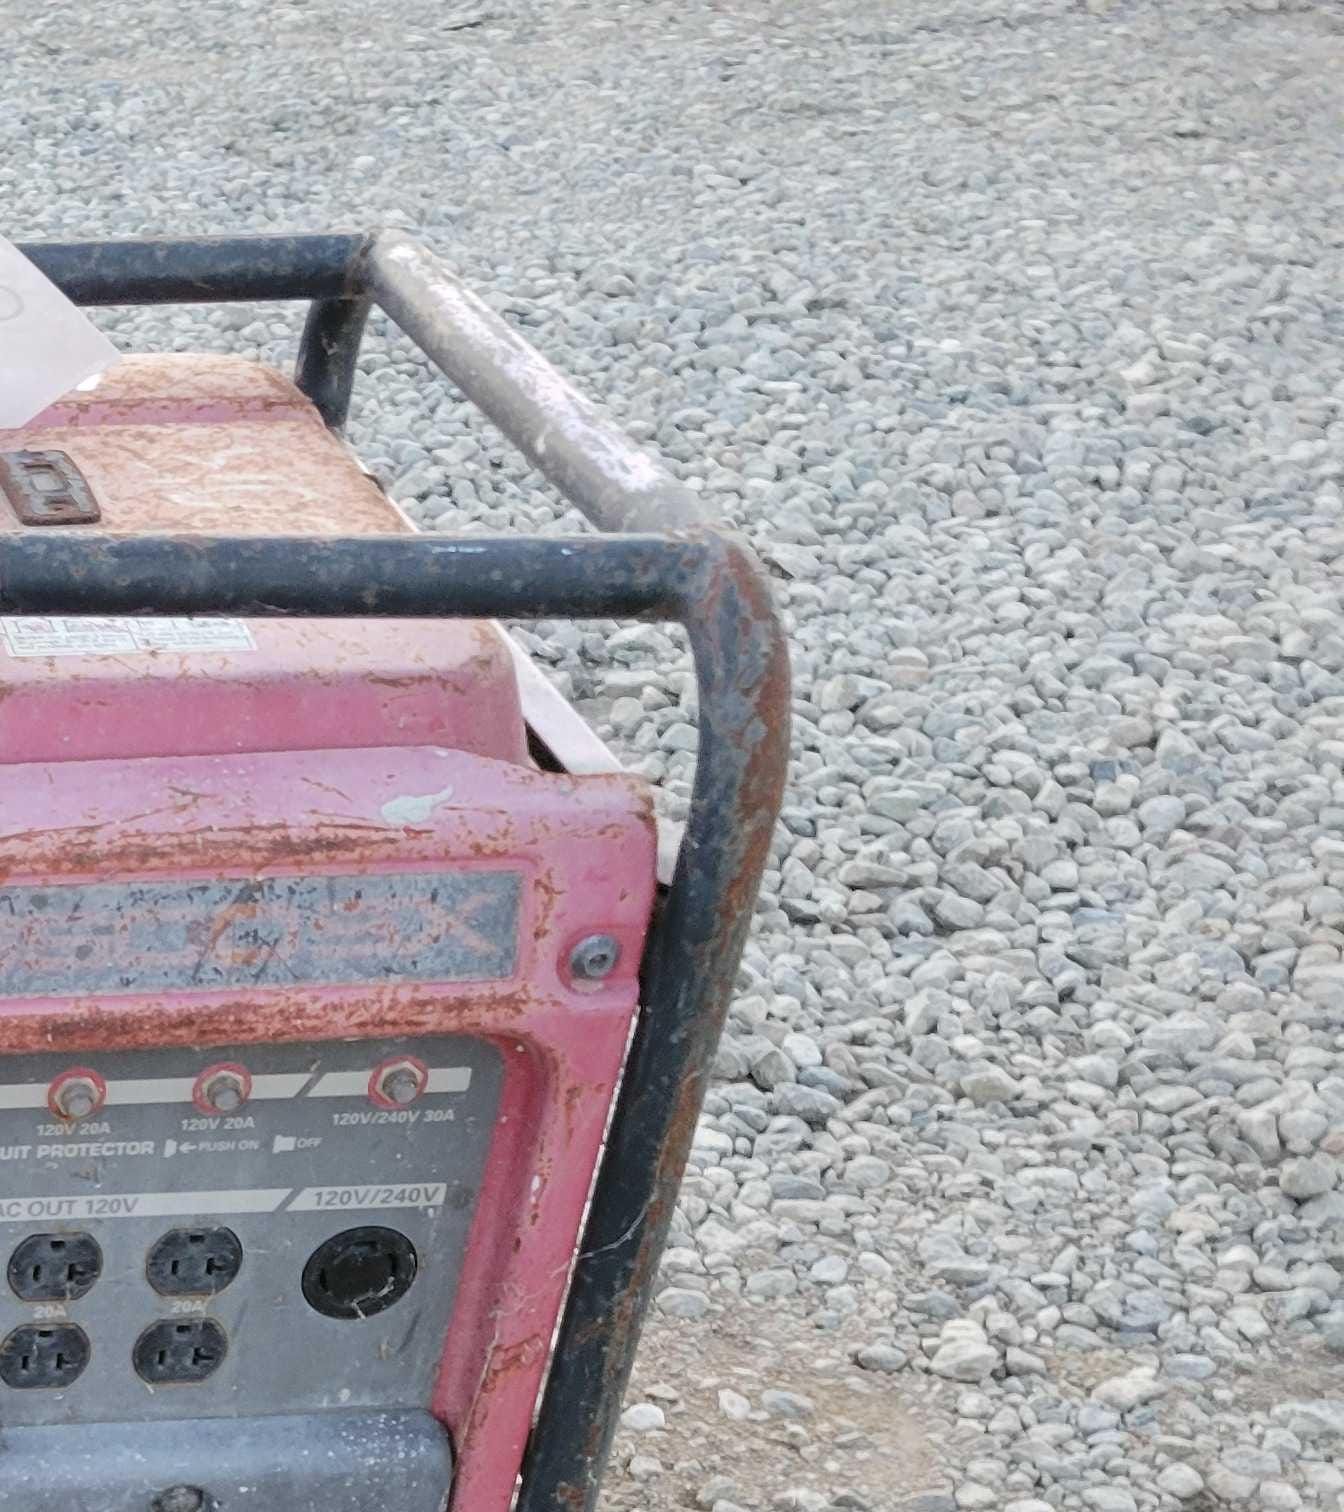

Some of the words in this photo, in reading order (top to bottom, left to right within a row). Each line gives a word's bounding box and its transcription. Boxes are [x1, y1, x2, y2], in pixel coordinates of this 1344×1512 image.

[181, 1117, 220, 1131] 120V
[224, 1116, 255, 1129] 20A
[332, 1110, 420, 1126] 120V/240V
[424, 1109, 455, 1123] 30A
[36, 1122, 74, 1136] 120V
[79, 1121, 111, 1135] 20A
[36, 1141, 154, 1159] PROTECTOR
[198, 1140, 236, 1151] PUSH
[238, 1140, 260, 1150] ON
[297, 1137, 323, 1148] OFF
[314, 1186, 440, 1206] 120V/240V
[27, 1200, 76, 1216] OUT
[84, 1197, 139, 1215] 120V
